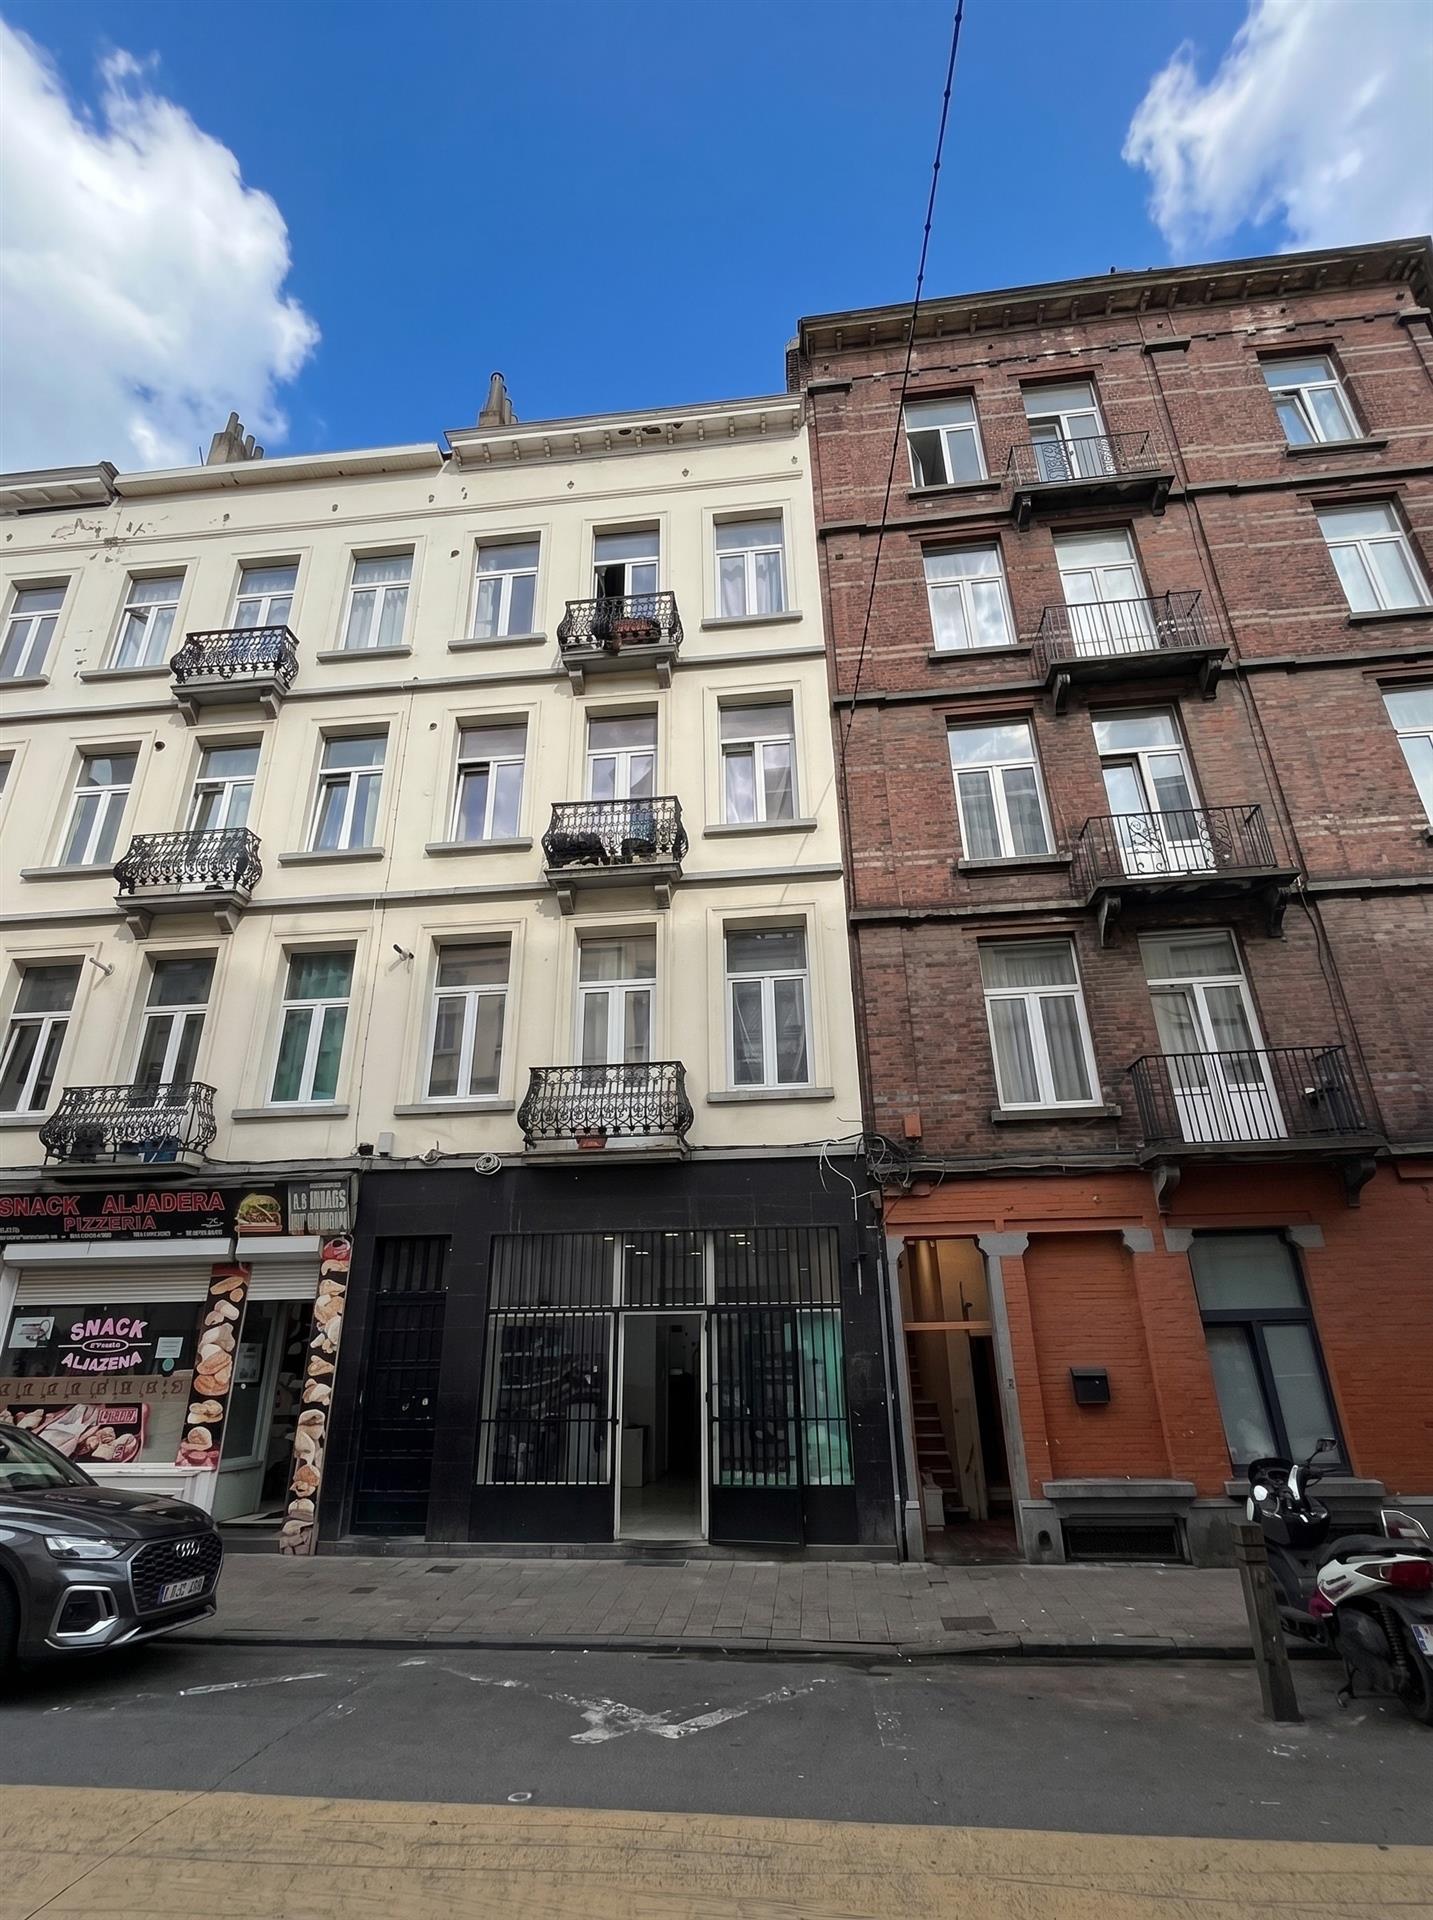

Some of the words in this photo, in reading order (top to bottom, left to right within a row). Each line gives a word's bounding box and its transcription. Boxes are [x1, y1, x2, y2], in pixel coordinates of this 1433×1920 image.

[0, 1195, 80, 1217] SNACK
[102, 1191, 226, 1214] ALJADERA
[64, 1216, 157, 1232] PIZZERIA
[70, 1317, 148, 1341] SNACK
